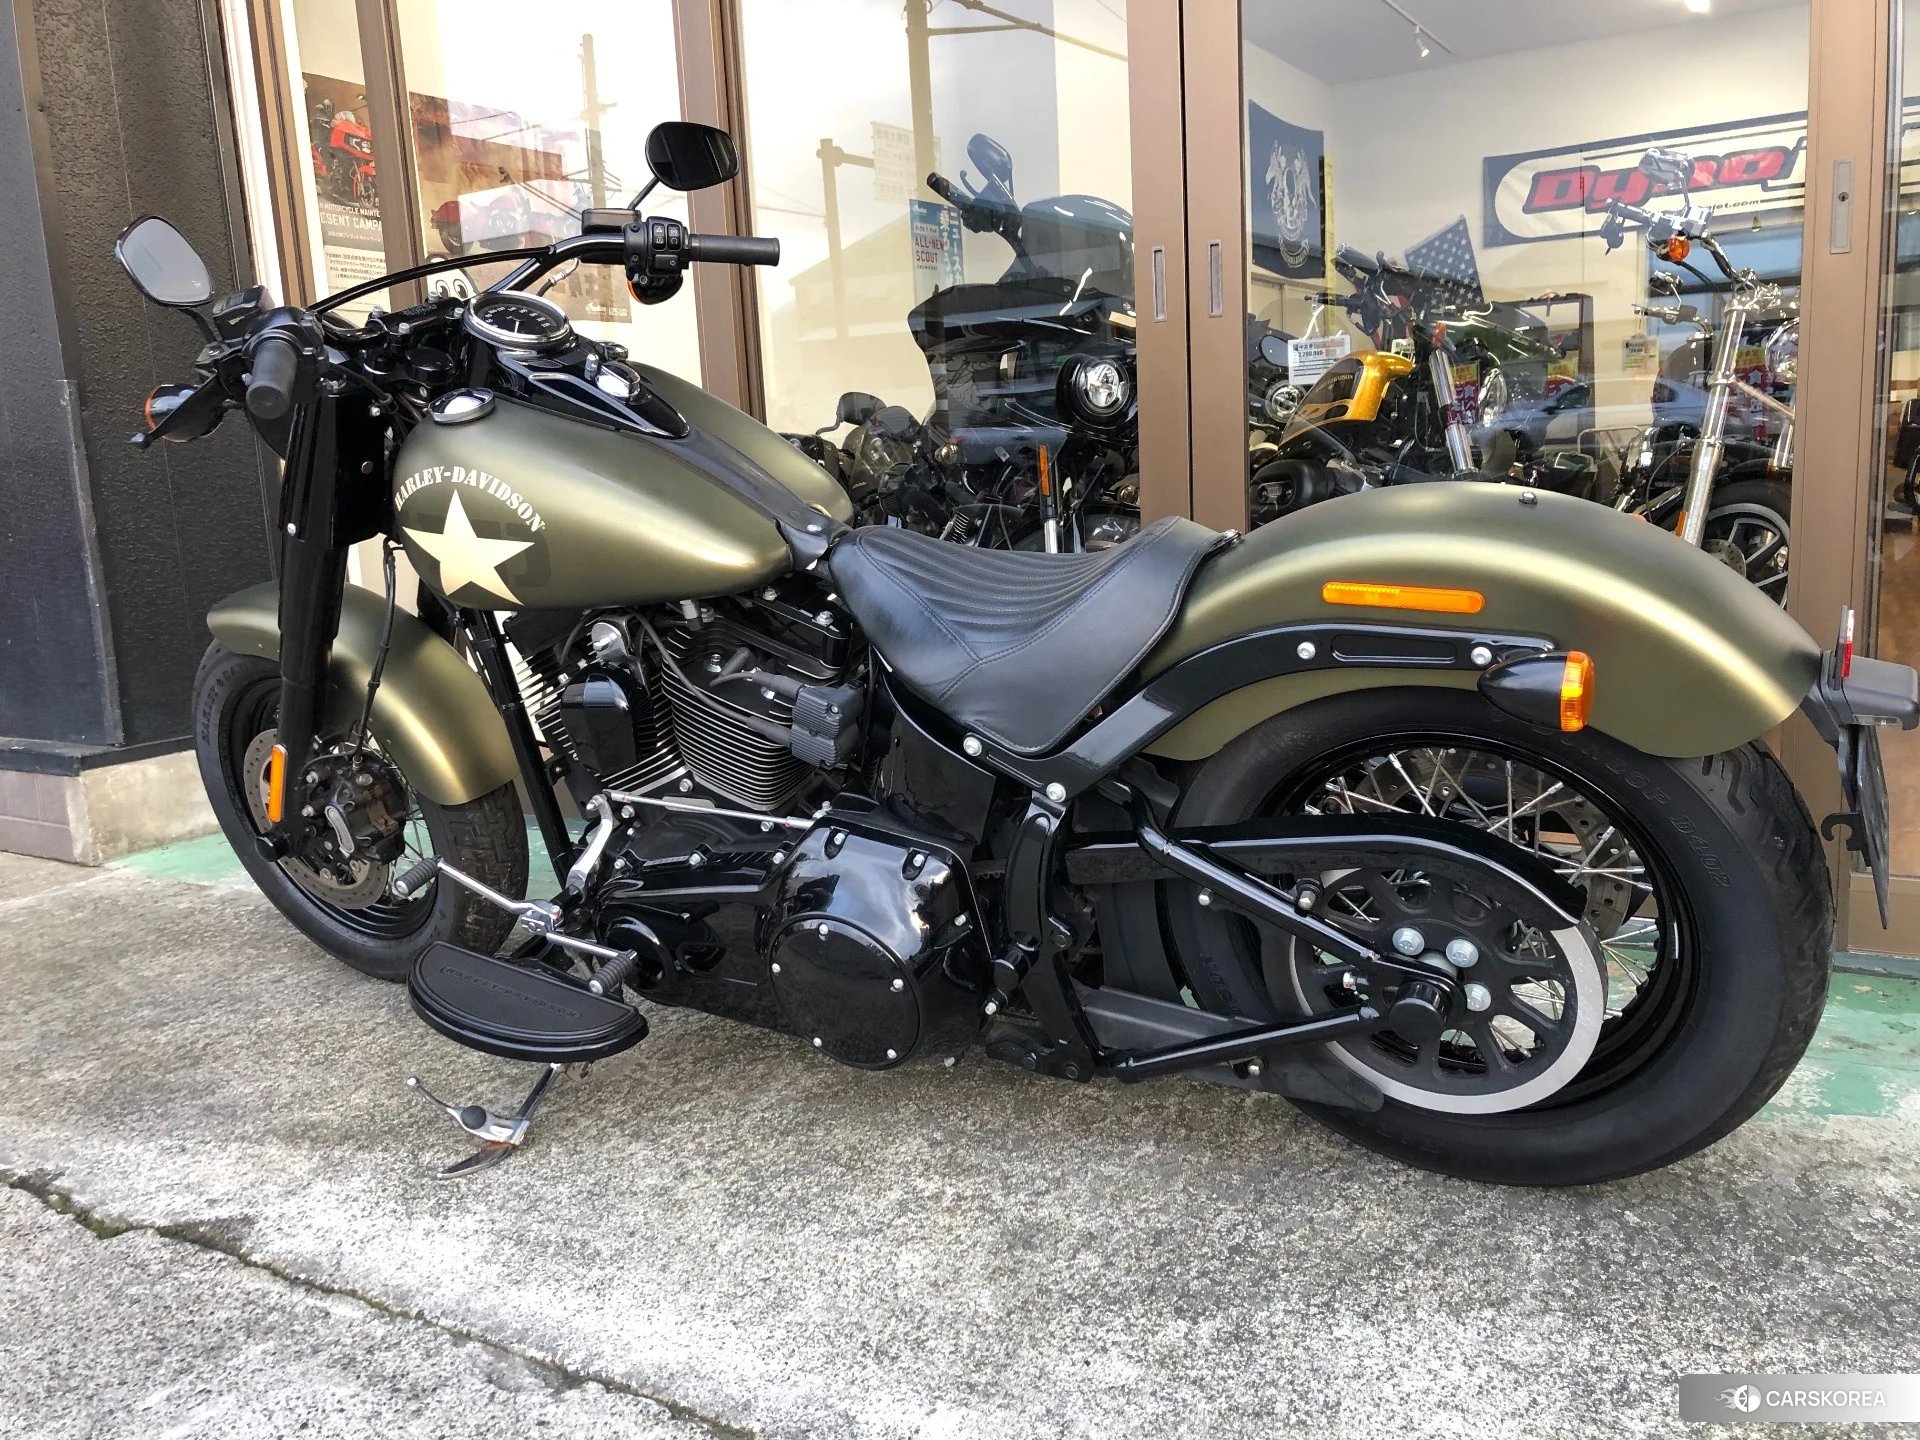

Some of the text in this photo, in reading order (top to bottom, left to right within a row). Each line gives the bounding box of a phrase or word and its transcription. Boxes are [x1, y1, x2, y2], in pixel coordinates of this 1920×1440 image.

[325, 203, 359, 215] MOTORCYCLE
[915, 236, 944, 251] ALL-NEW
[916, 251, 938, 263] SCOUT
[394, 466, 546, 532] HARLEY-DAVIDSON
[1668, 814, 1733, 889] D402
